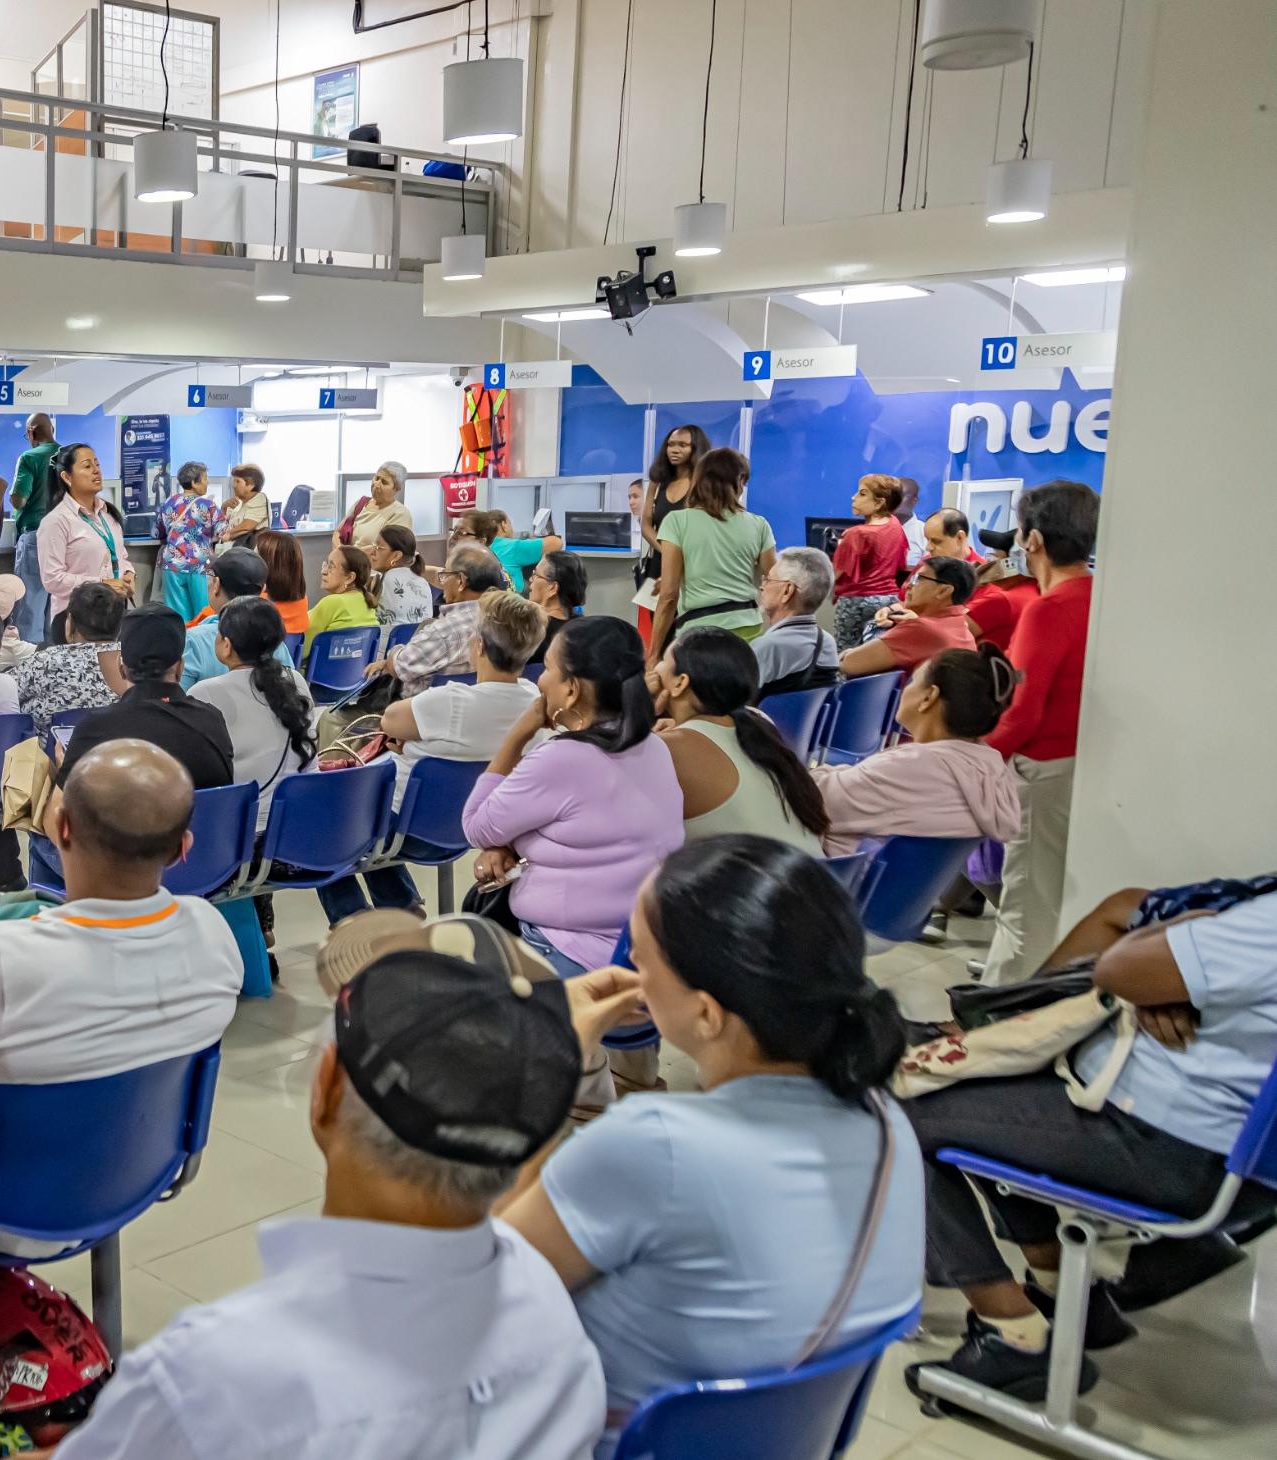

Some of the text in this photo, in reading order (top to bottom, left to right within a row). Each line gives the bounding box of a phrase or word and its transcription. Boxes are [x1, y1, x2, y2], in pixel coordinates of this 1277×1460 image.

[985, 342, 1073, 365] 10 Asesor
[751, 356, 815, 376] 9 Asesor
[489, 367, 539, 385] 8 Asesor
[0, 384, 43, 402] 5 Asesor
[193, 388, 229, 404] 6 Asesor
[324, 391, 331, 406] 7
